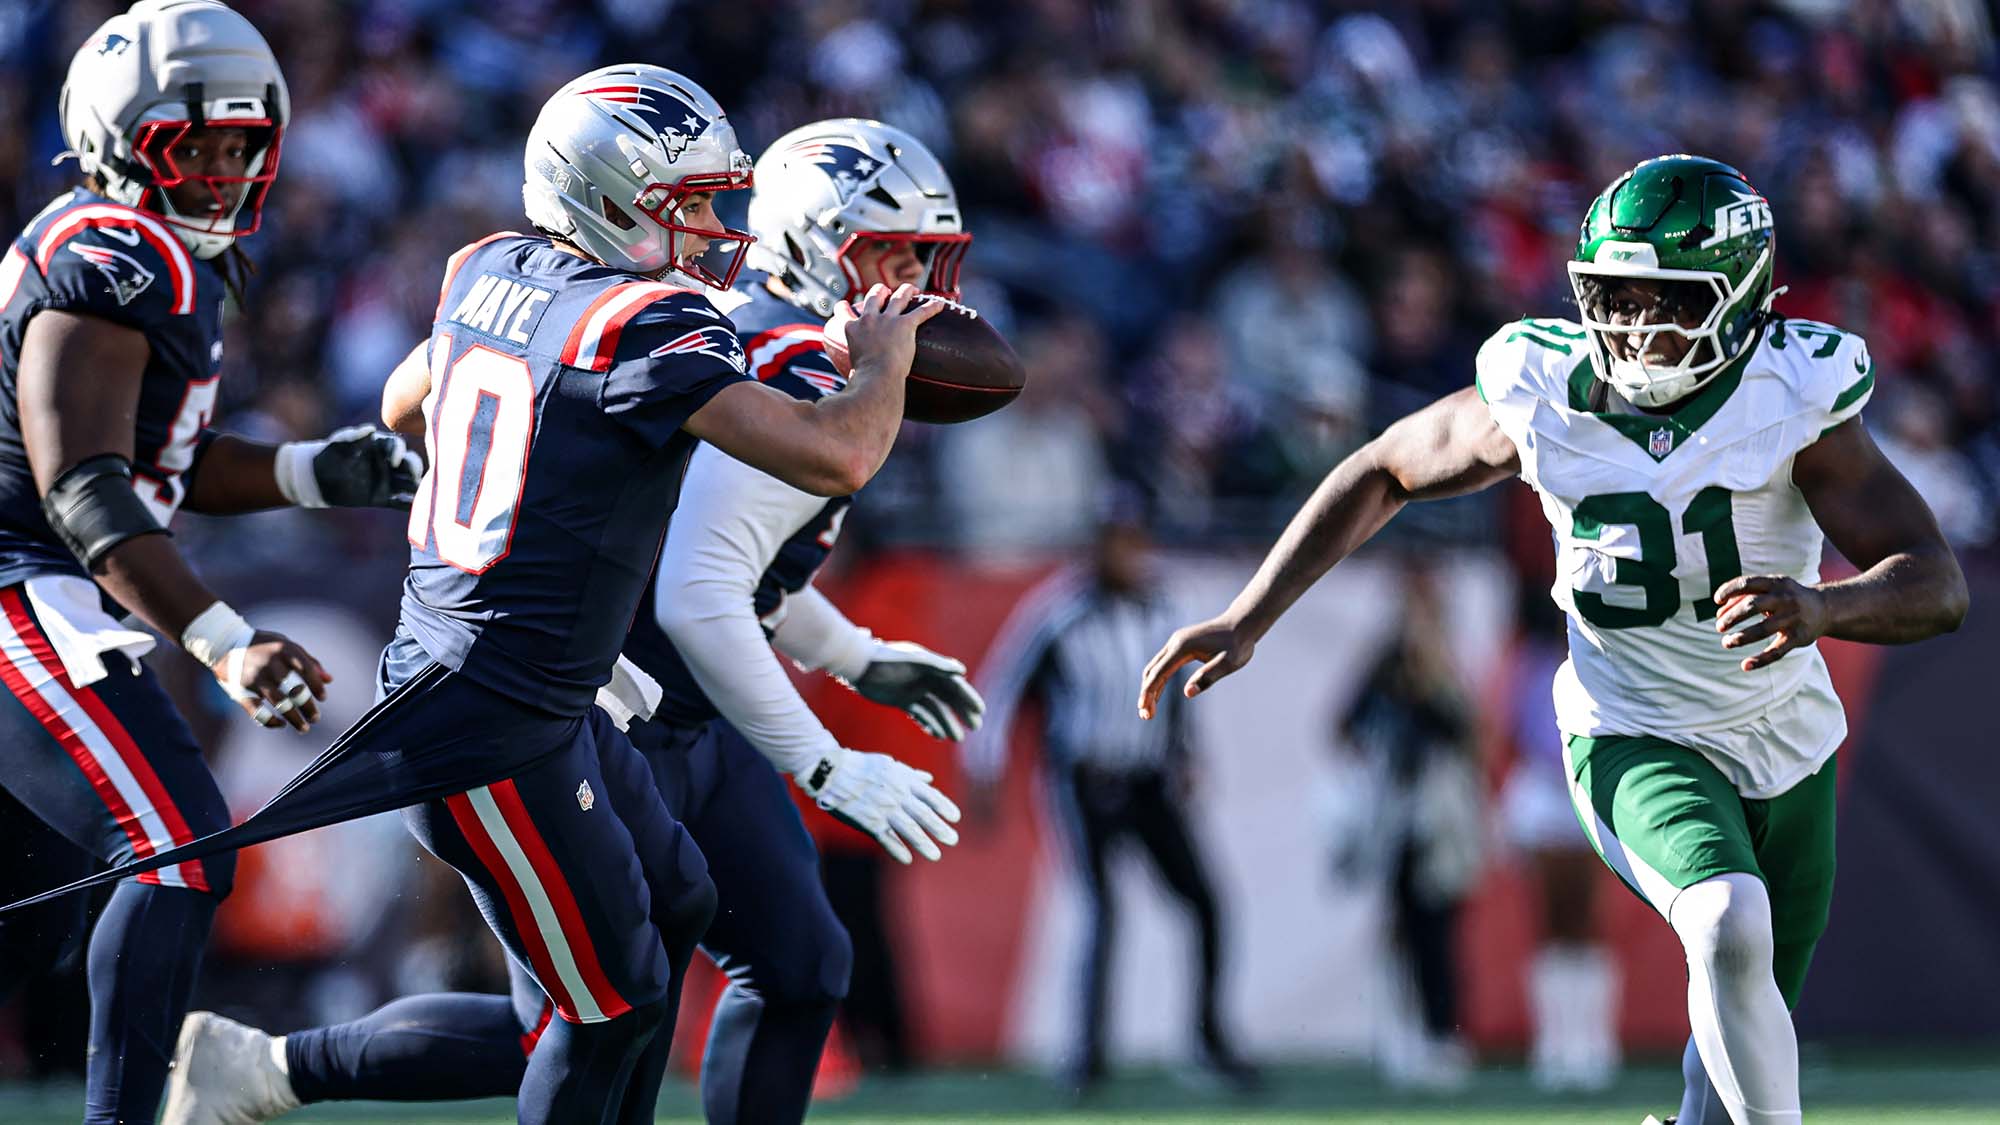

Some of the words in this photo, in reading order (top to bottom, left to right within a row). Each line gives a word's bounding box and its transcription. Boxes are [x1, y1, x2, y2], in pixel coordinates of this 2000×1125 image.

[1701, 190, 1774, 250] JETS
[450, 275, 549, 345] MAYE
[408, 333, 535, 576] 10
[1572, 486, 1742, 630] 31
